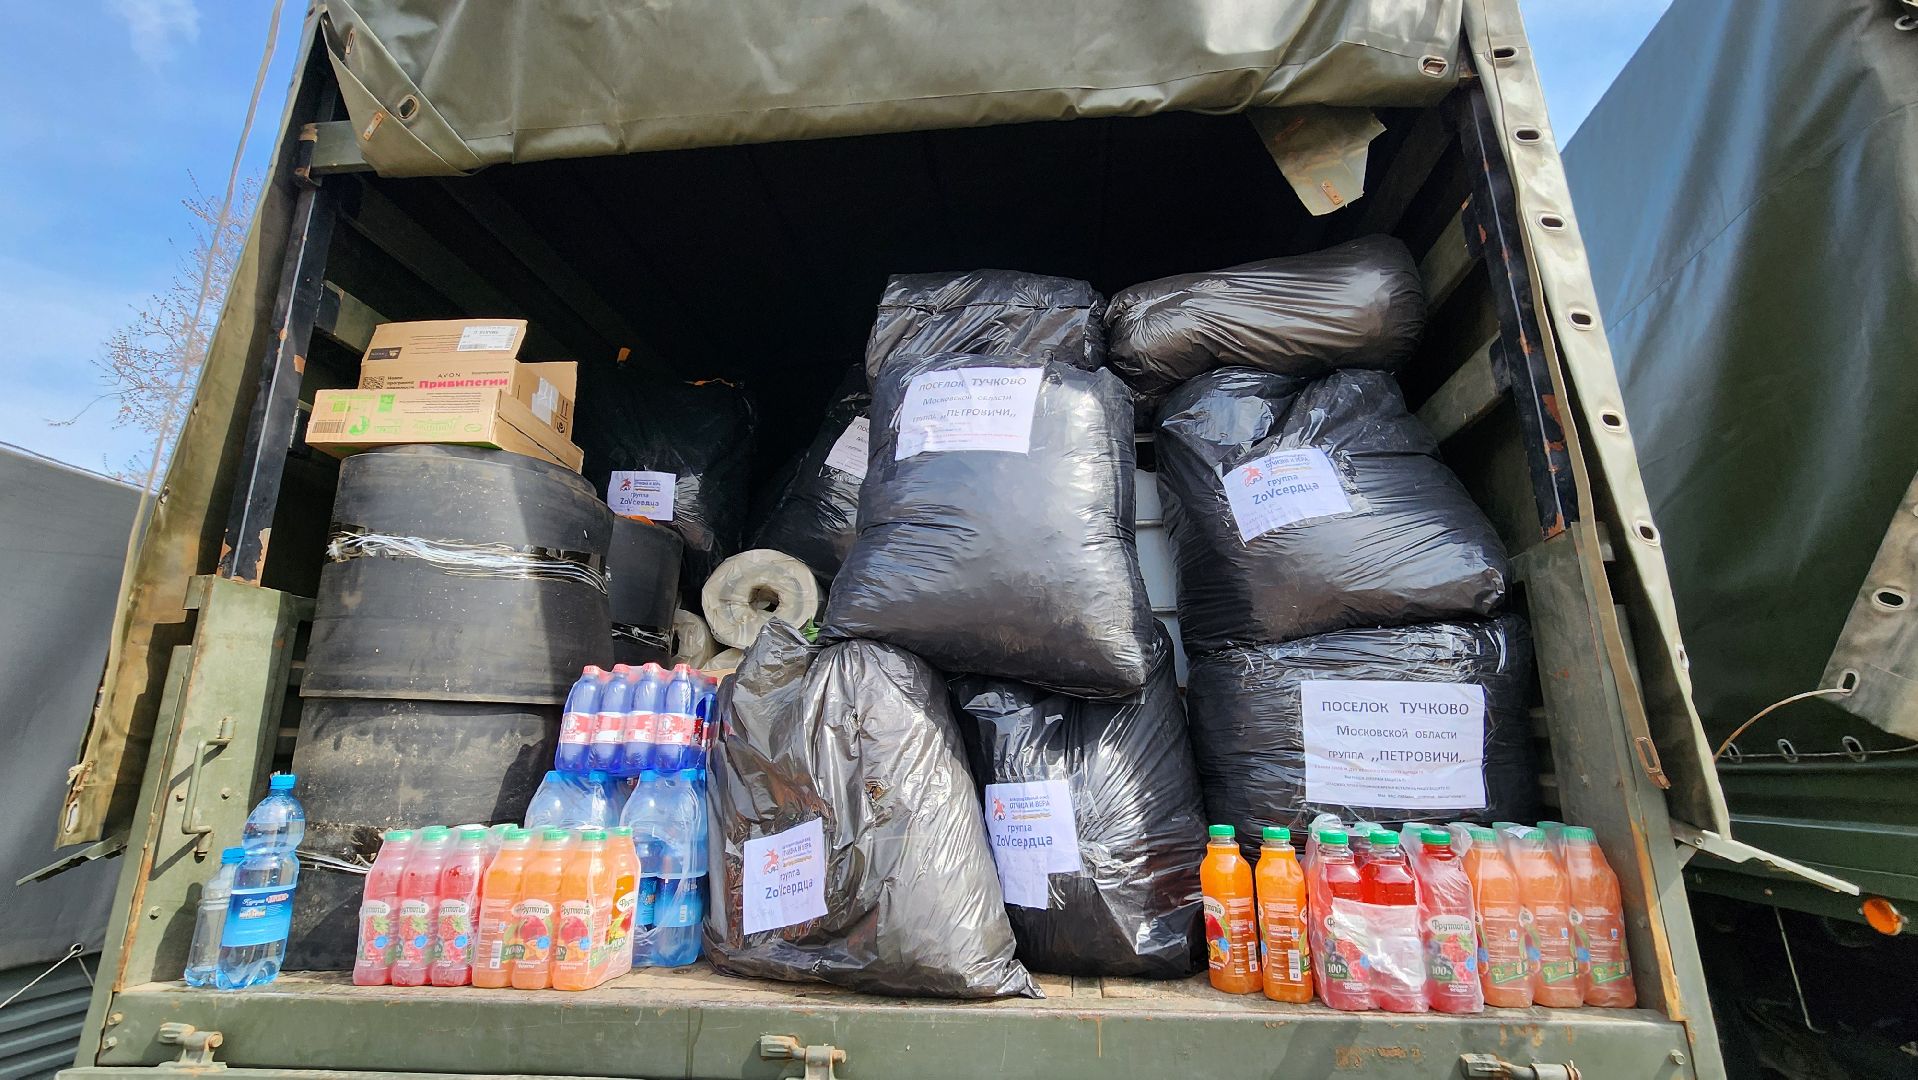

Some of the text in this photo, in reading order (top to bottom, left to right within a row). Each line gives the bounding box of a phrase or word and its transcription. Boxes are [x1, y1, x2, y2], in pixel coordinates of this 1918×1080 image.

[418, 378, 509, 390] Привилегии
[918, 377, 1027, 392] ПОСЕЛОК ТУЧКОВО
[1267, 474, 1298, 487] группа
[1252, 481, 1320, 505] ZoVсердца
[1322, 701, 1469, 715] ПОСЕЛОК ТУЧКОВО
[996, 835, 1053, 849] ZoVсердца
[1327, 963, 1347, 974] 100%
[1431, 965, 1451, 976] 100%
